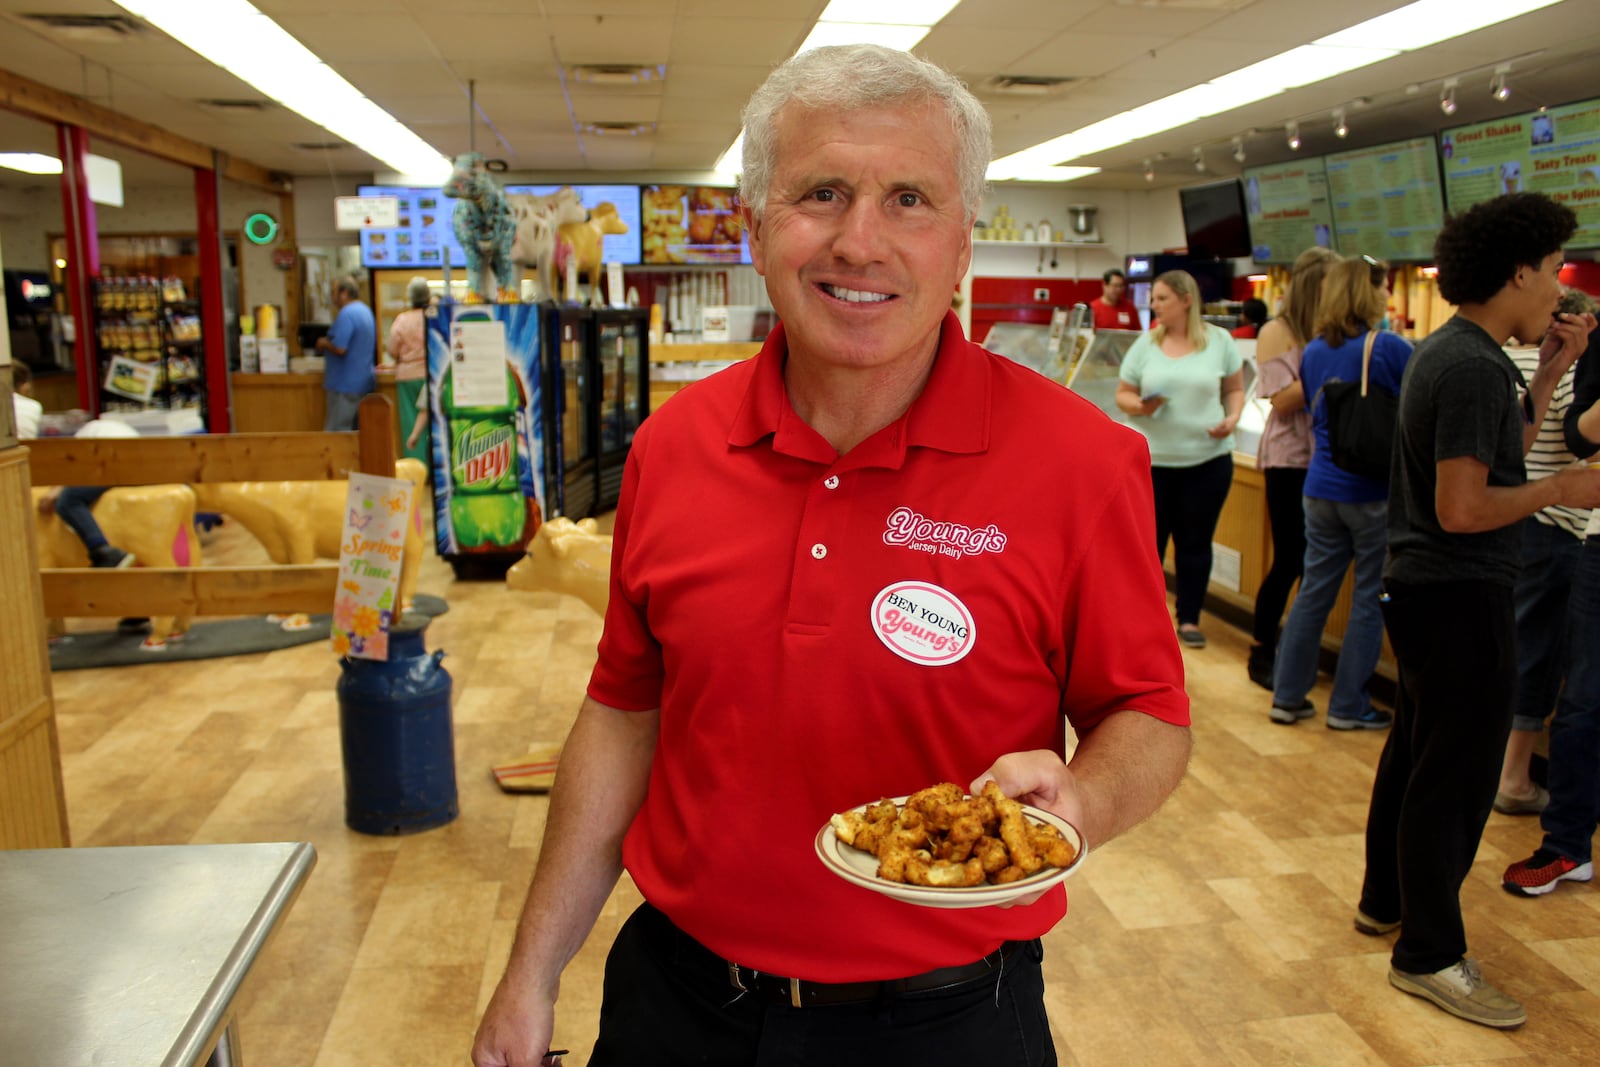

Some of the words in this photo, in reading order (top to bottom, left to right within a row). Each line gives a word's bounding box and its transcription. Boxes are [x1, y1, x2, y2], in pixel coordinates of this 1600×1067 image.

[1455, 130, 1483, 144] Great
[1485, 122, 1522, 139] Shakes
[1533, 159, 1560, 172] Tasty
[1562, 153, 1597, 167] Treats
[882, 506, 1008, 556] Young's
[343, 534, 402, 562] Spring
[908, 540, 938, 556] Jersey
[938, 543, 964, 561] Dairy
[349, 558, 392, 580] Time
[887, 592, 919, 614] BEN
[920, 607, 969, 639] YOUNG
[881, 609, 961, 654] Young's
